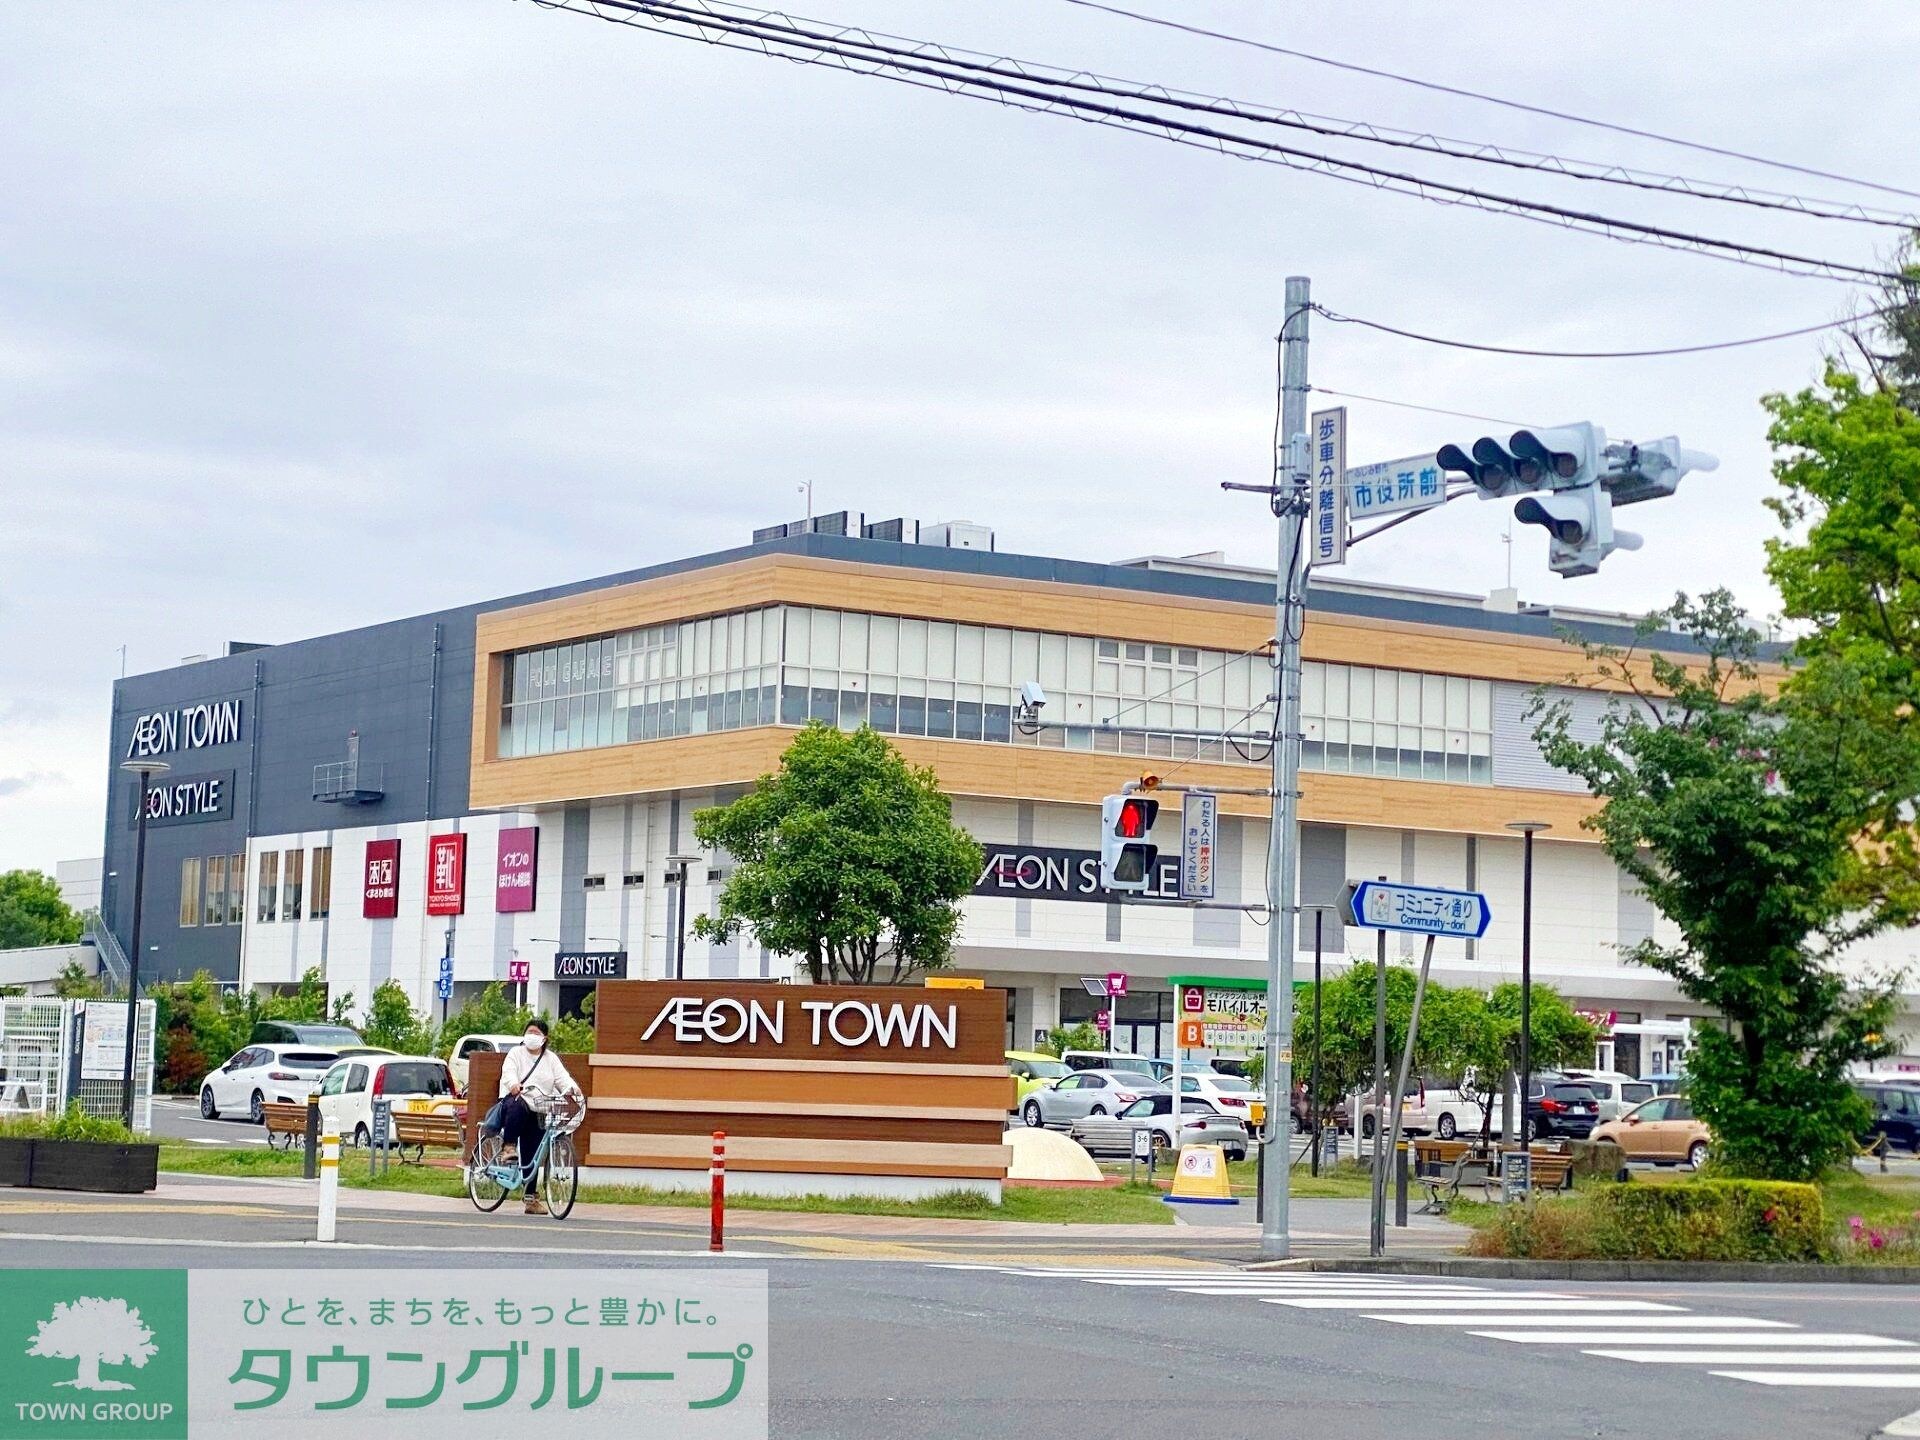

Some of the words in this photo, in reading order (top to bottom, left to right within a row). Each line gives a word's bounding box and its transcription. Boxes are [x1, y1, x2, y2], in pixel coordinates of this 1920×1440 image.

[1319, 417, 1335, 558] 歩車分離信号
[1354, 467, 1437, 508] 市役所前
[183, 699, 239, 749] TOWN
[175, 780, 219, 816] STYLE
[502, 851, 529, 868] イオンの
[1187, 827, 1198, 892] おしてください
[1396, 893, 1473, 919] コミュニティ通り
[585, 956, 615, 975] STYLE
[801, 1000, 957, 1048] TOWN
[1187, 1025, 1198, 1042] B
